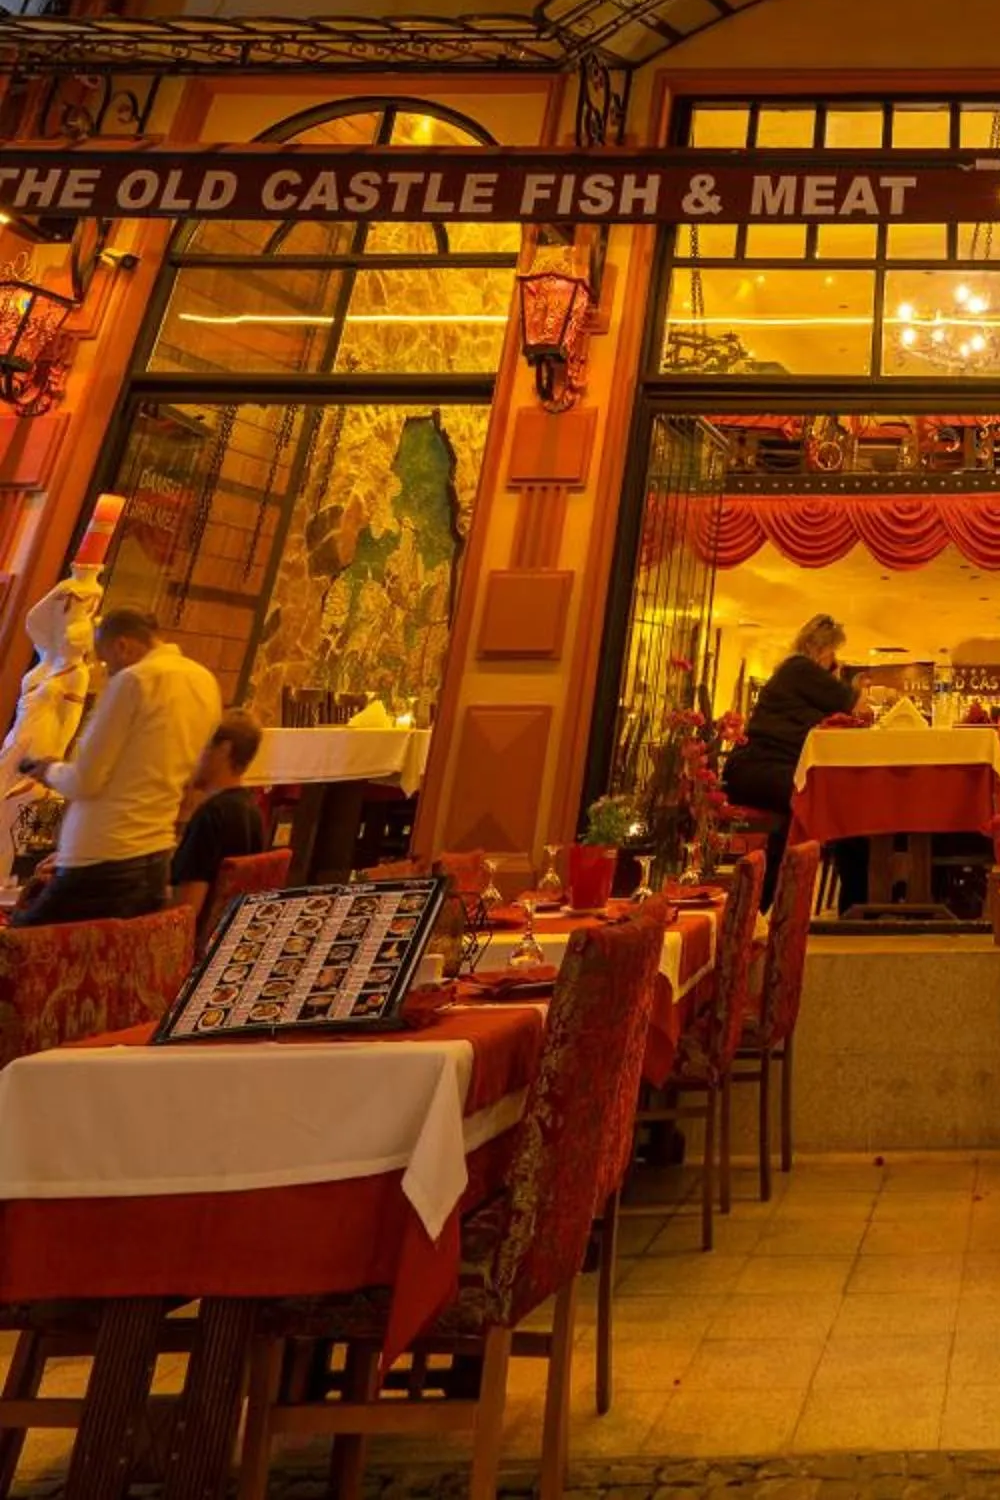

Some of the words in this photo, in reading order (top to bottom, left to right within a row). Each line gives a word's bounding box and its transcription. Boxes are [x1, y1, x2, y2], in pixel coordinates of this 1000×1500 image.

[116, 169, 239, 211] OLD
[261, 171, 498, 214] CASTLE
[519, 173, 660, 215] FISH
[681, 174, 722, 215] &
[749, 175, 918, 216] MEAT
